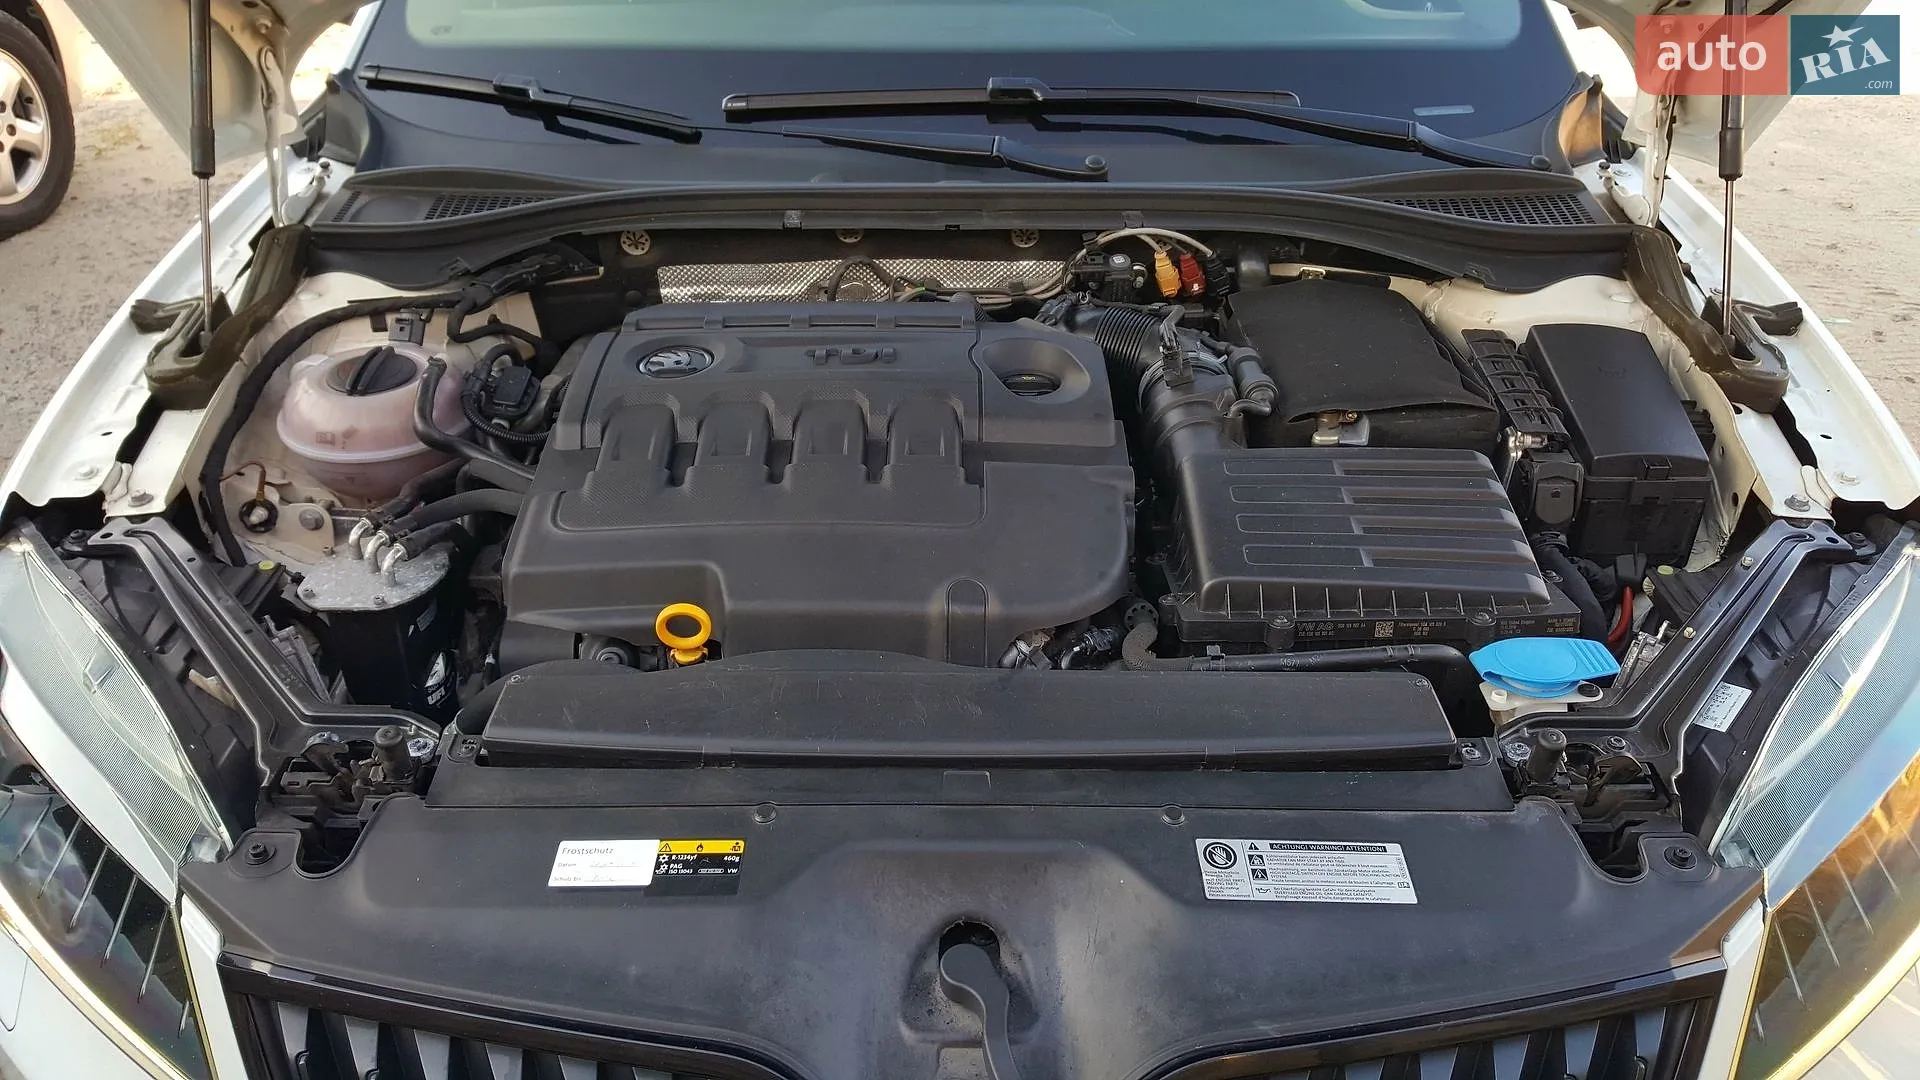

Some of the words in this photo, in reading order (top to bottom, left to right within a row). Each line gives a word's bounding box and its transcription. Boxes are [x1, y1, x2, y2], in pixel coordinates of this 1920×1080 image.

[806, 347, 898, 365] TDI
[561, 847, 613, 855] Frostschutz
[671, 854, 698, 862] R-1234yf
